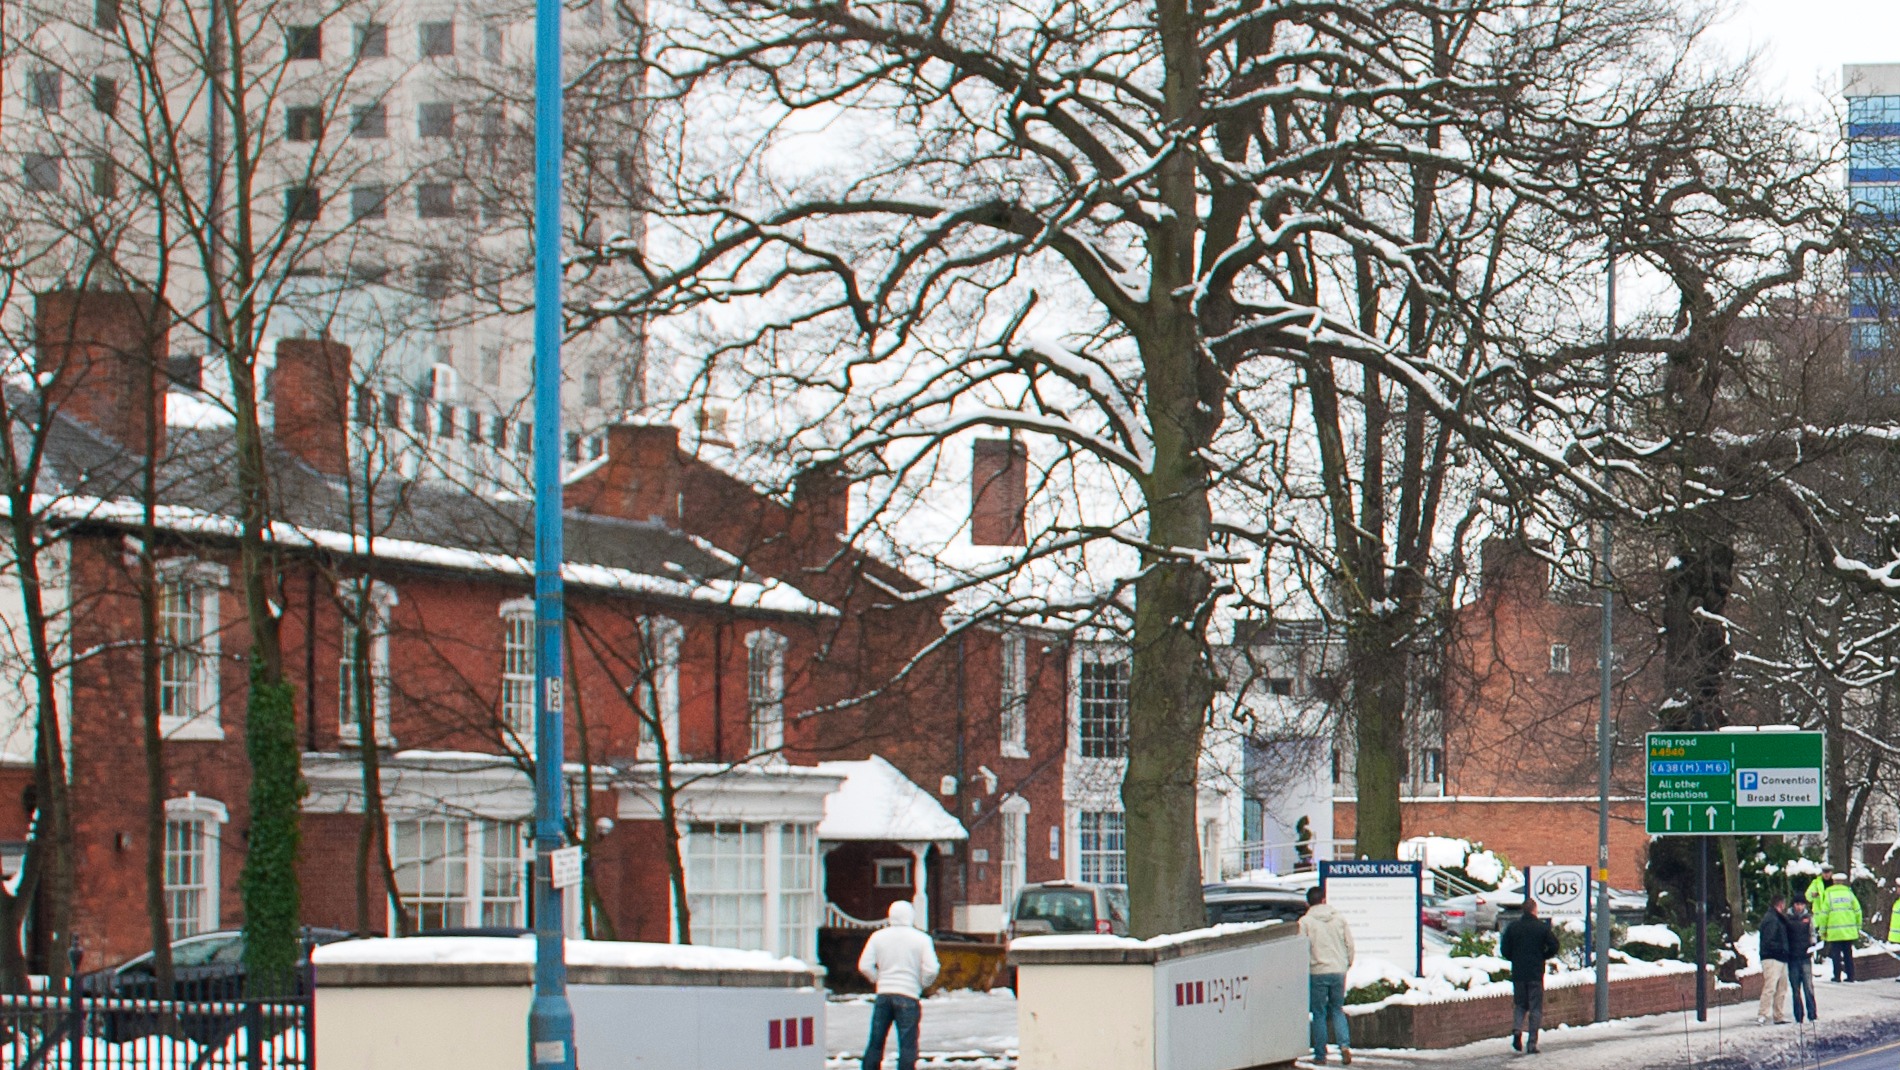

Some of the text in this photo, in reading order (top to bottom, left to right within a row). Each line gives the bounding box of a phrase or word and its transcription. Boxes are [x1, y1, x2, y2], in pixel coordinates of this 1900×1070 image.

[1651, 737, 1698, 748] Ring road
[1658, 780, 1700, 788] All other
[1761, 775, 1817, 785] Convention
[1650, 790, 1709, 799] destinations
[1747, 794, 1811, 802] Broad Street
[1329, 864, 1414, 874] NETWORK HOUSE
[1538, 877, 1577, 896] Jobs
[1207, 976, 1249, 1013] 123-127
